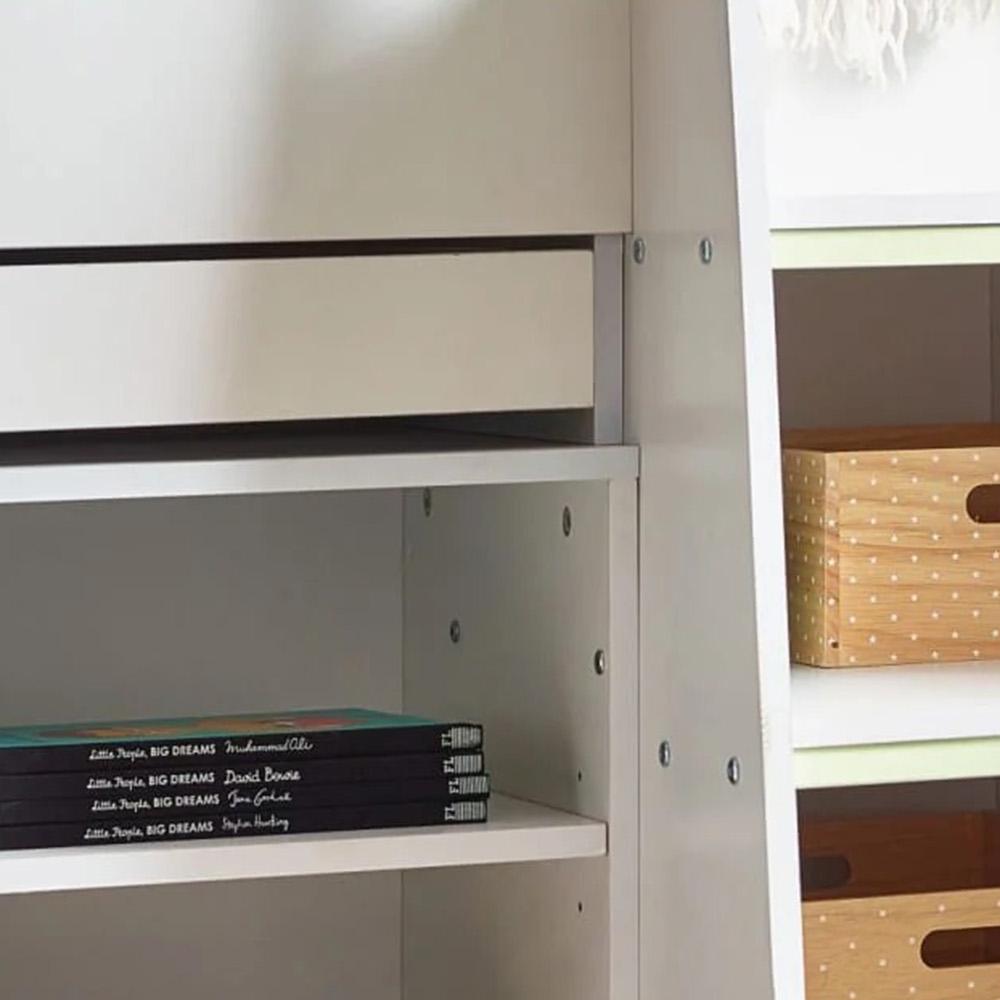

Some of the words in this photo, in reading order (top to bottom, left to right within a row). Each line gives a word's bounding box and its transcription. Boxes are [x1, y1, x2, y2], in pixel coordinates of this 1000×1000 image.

[89, 749, 114, 760] Little
[150, 746, 169, 757] BIG
[172, 744, 216, 756] DREAMS
[290, 737, 313, 751] Ali
[86, 778, 112, 789] Little
[148, 775, 167, 785] BIG
[170, 772, 215, 784] DREAMS
[224, 769, 261, 785] David
[264, 766, 301, 782] Bowie
[91, 800, 117, 811] Little
[153, 797, 173, 808] BIG
[175, 794, 220, 806] DREAMS
[84, 828, 110, 839] Little
[146, 824, 165, 835] BIG
[168, 821, 213, 834] DREAMS
